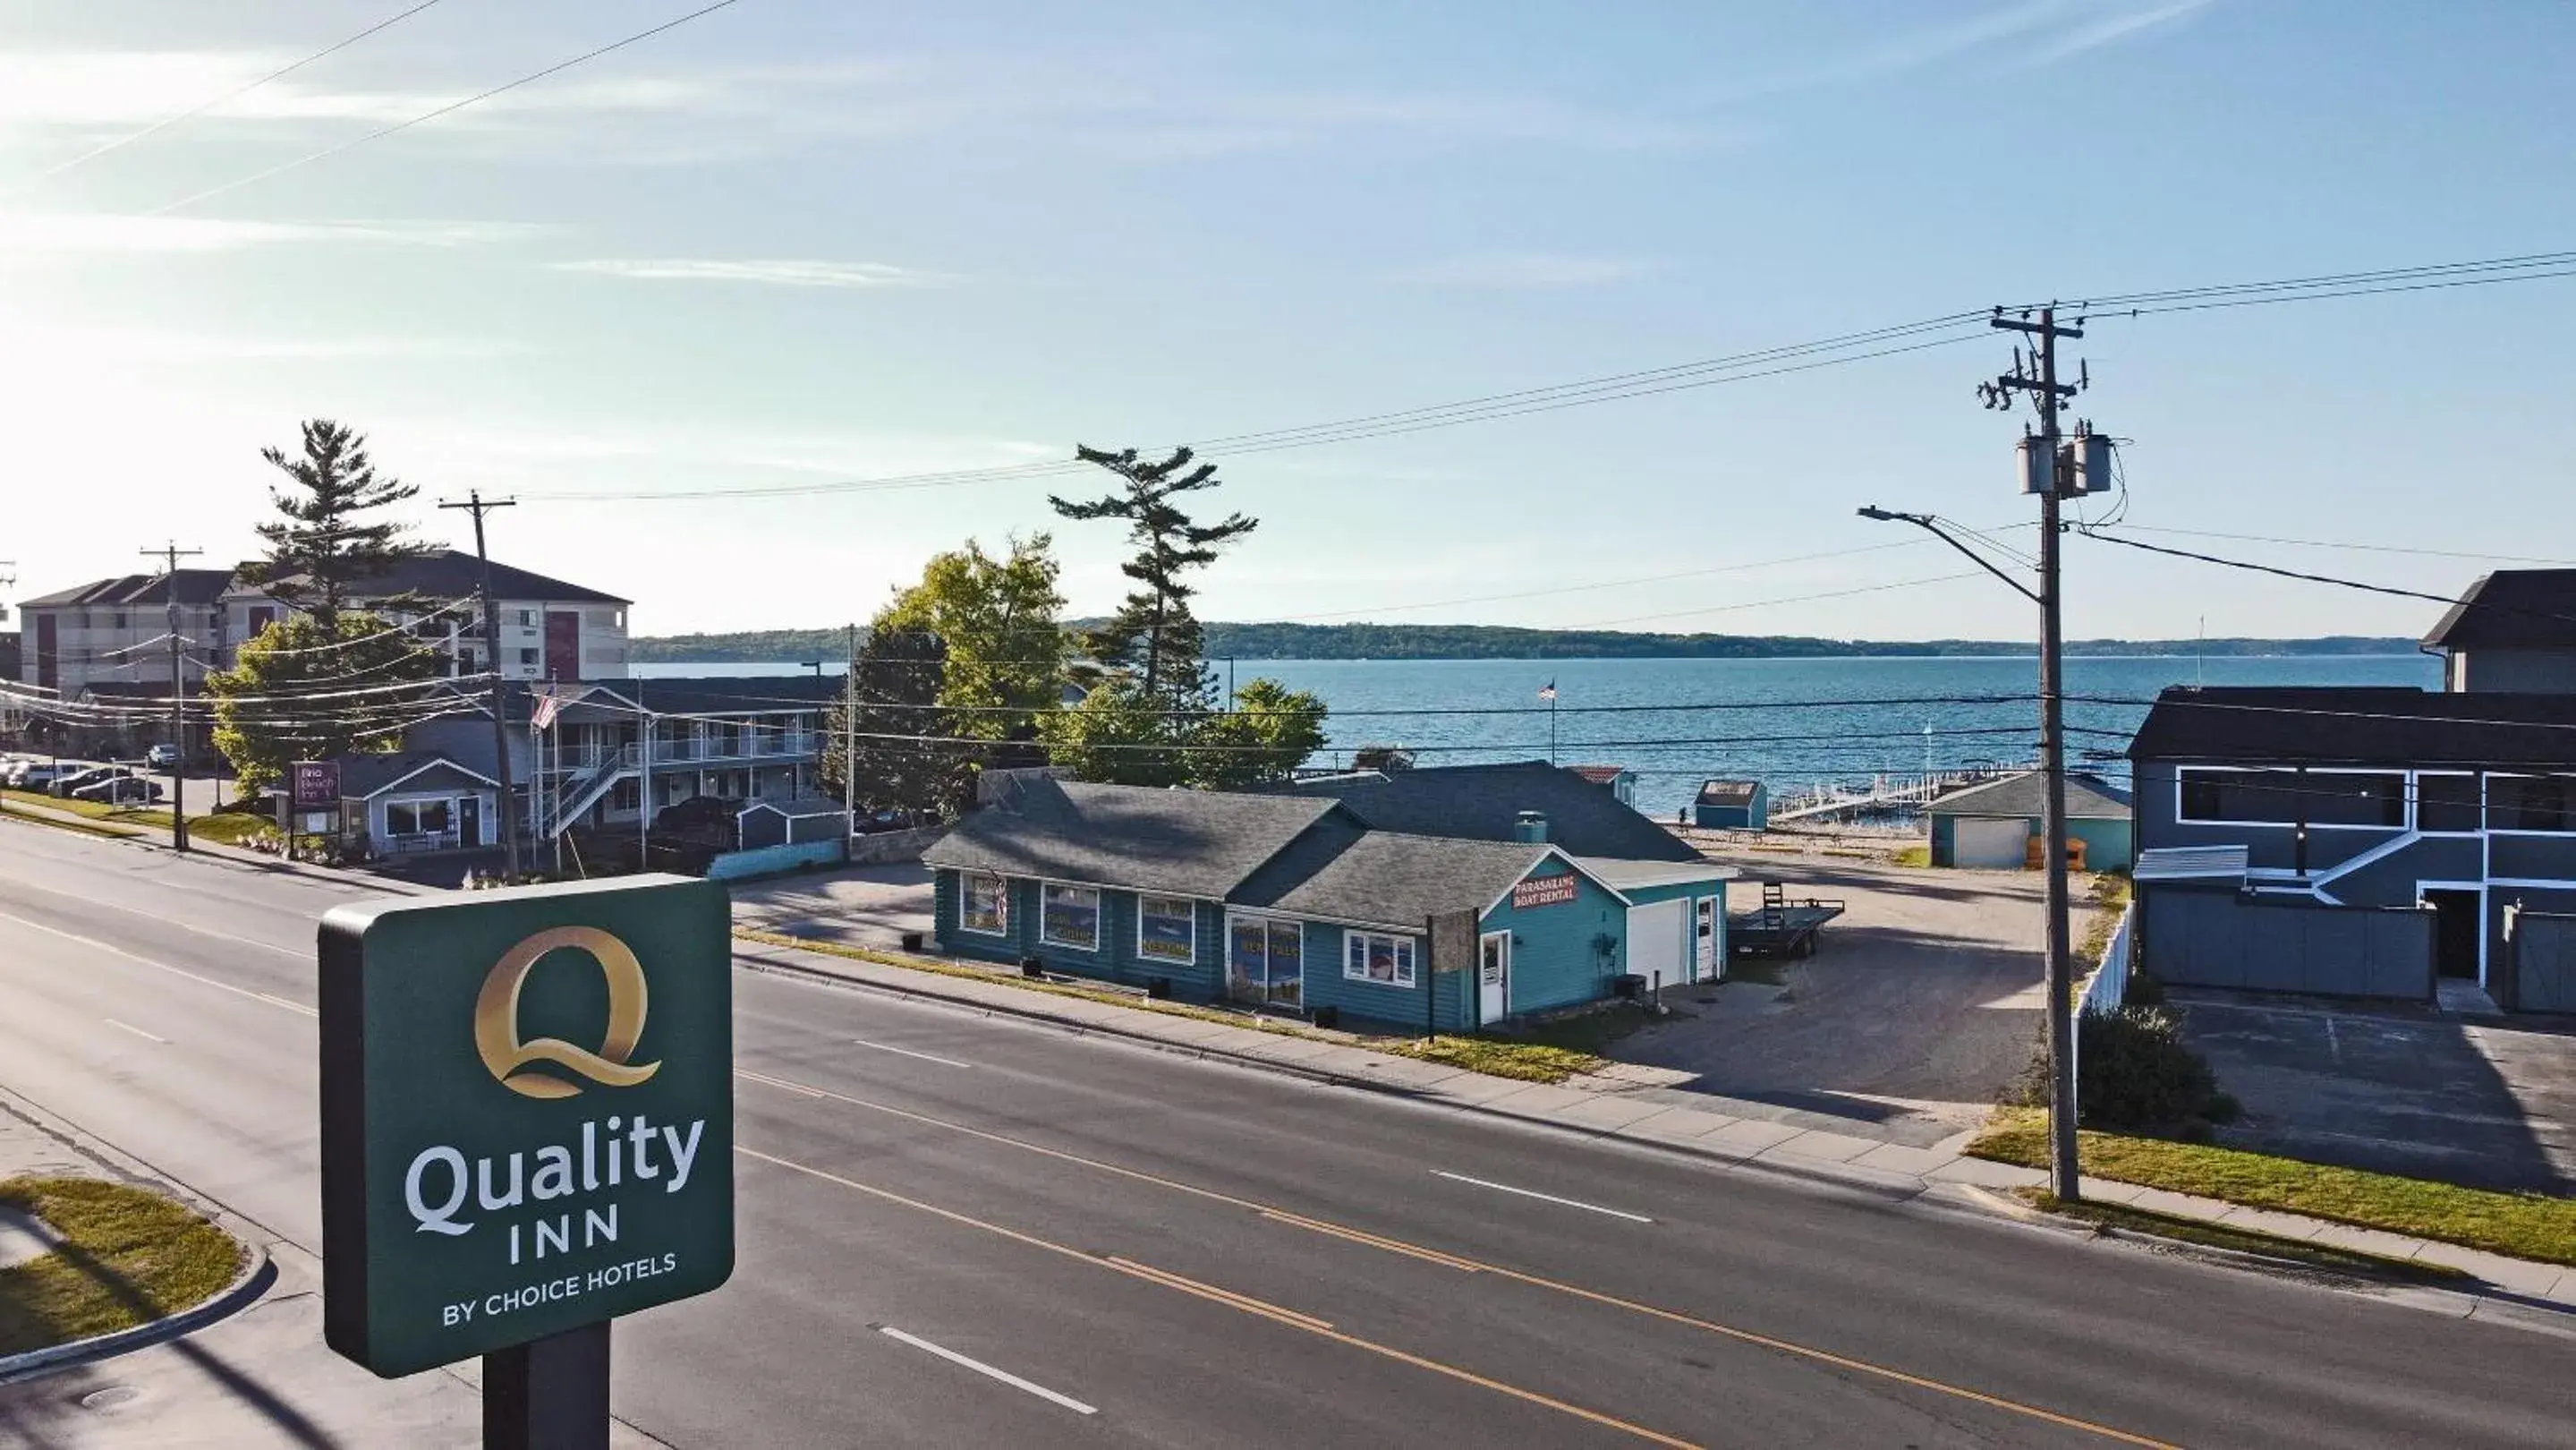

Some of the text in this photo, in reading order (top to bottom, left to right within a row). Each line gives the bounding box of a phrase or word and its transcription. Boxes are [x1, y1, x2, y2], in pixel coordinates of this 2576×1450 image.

[1514, 889, 1573, 908] BOAT RENTAL
[405, 1115, 705, 1236] Quality
[510, 1204, 618, 1265] INN
[444, 1253, 676, 1326] BY CHOICE HOTELS
